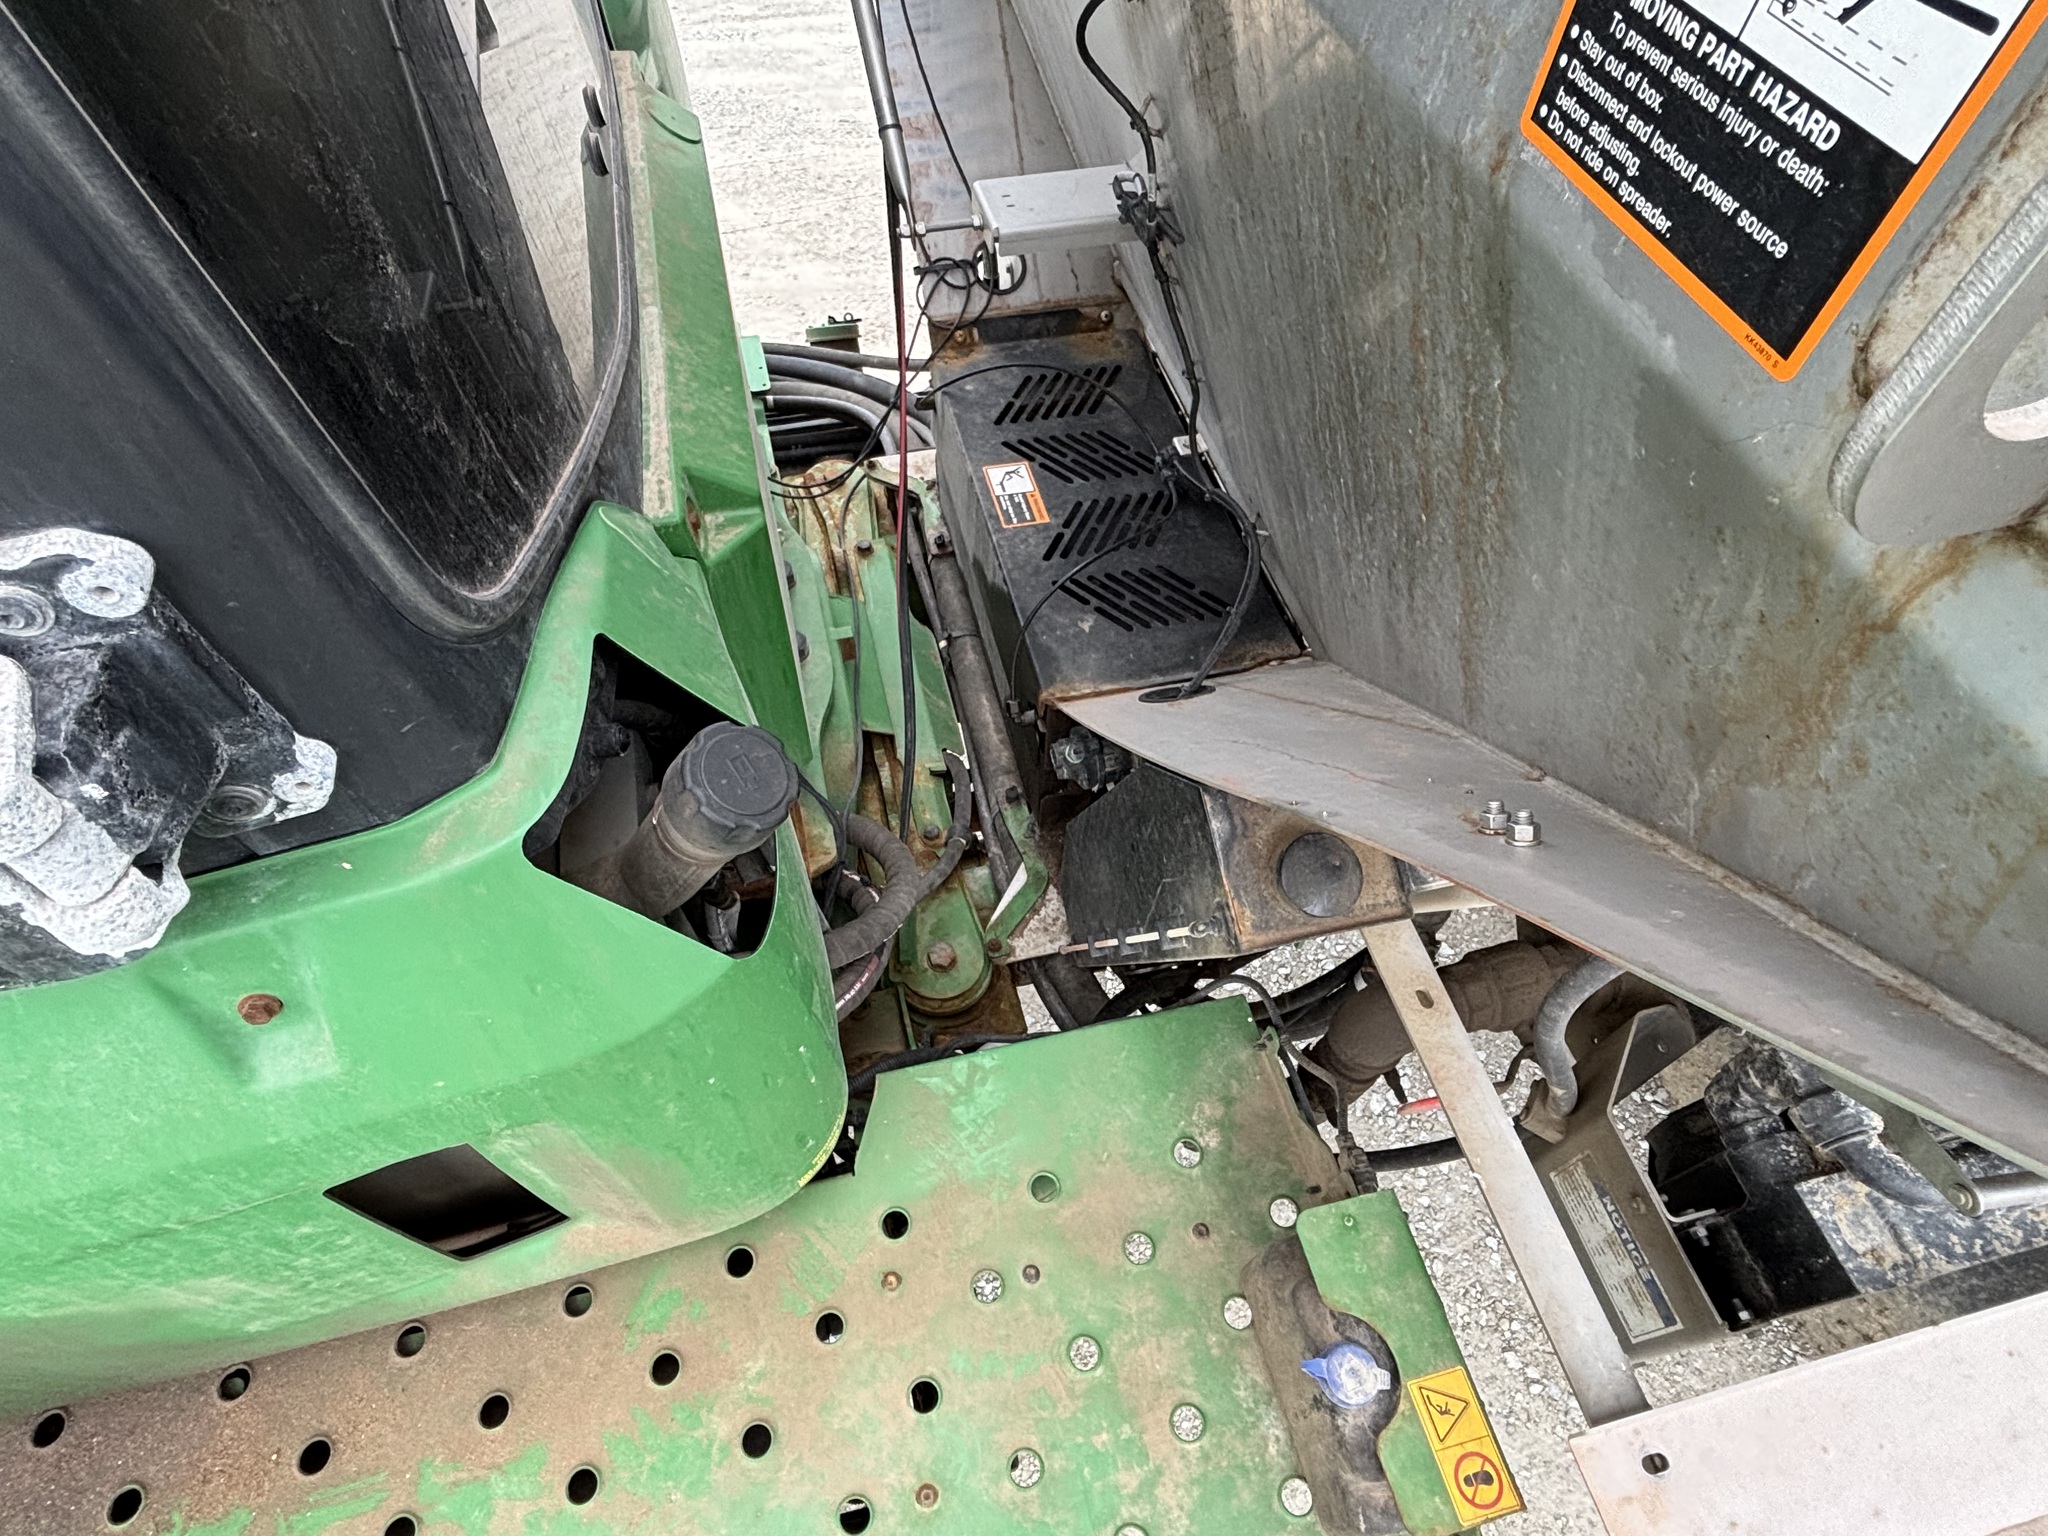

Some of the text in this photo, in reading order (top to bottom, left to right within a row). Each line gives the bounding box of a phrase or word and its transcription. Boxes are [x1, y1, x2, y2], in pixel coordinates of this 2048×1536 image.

[1555, 86, 1641, 177] before adjusting.
[1579, 30, 1664, 115] Stay out of box.
[1609, 11, 1830, 198] To prevent serious injury or death:
[1697, 32, 1756, 87] PART
[1750, 70, 1841, 152] HAZARD
[1547, 109, 1673, 239] Do not ride on spreader.
[1567, 58, 1789, 259] Disconnect and lockout power source
[1601, 1195, 1652, 1281] NOTICE
